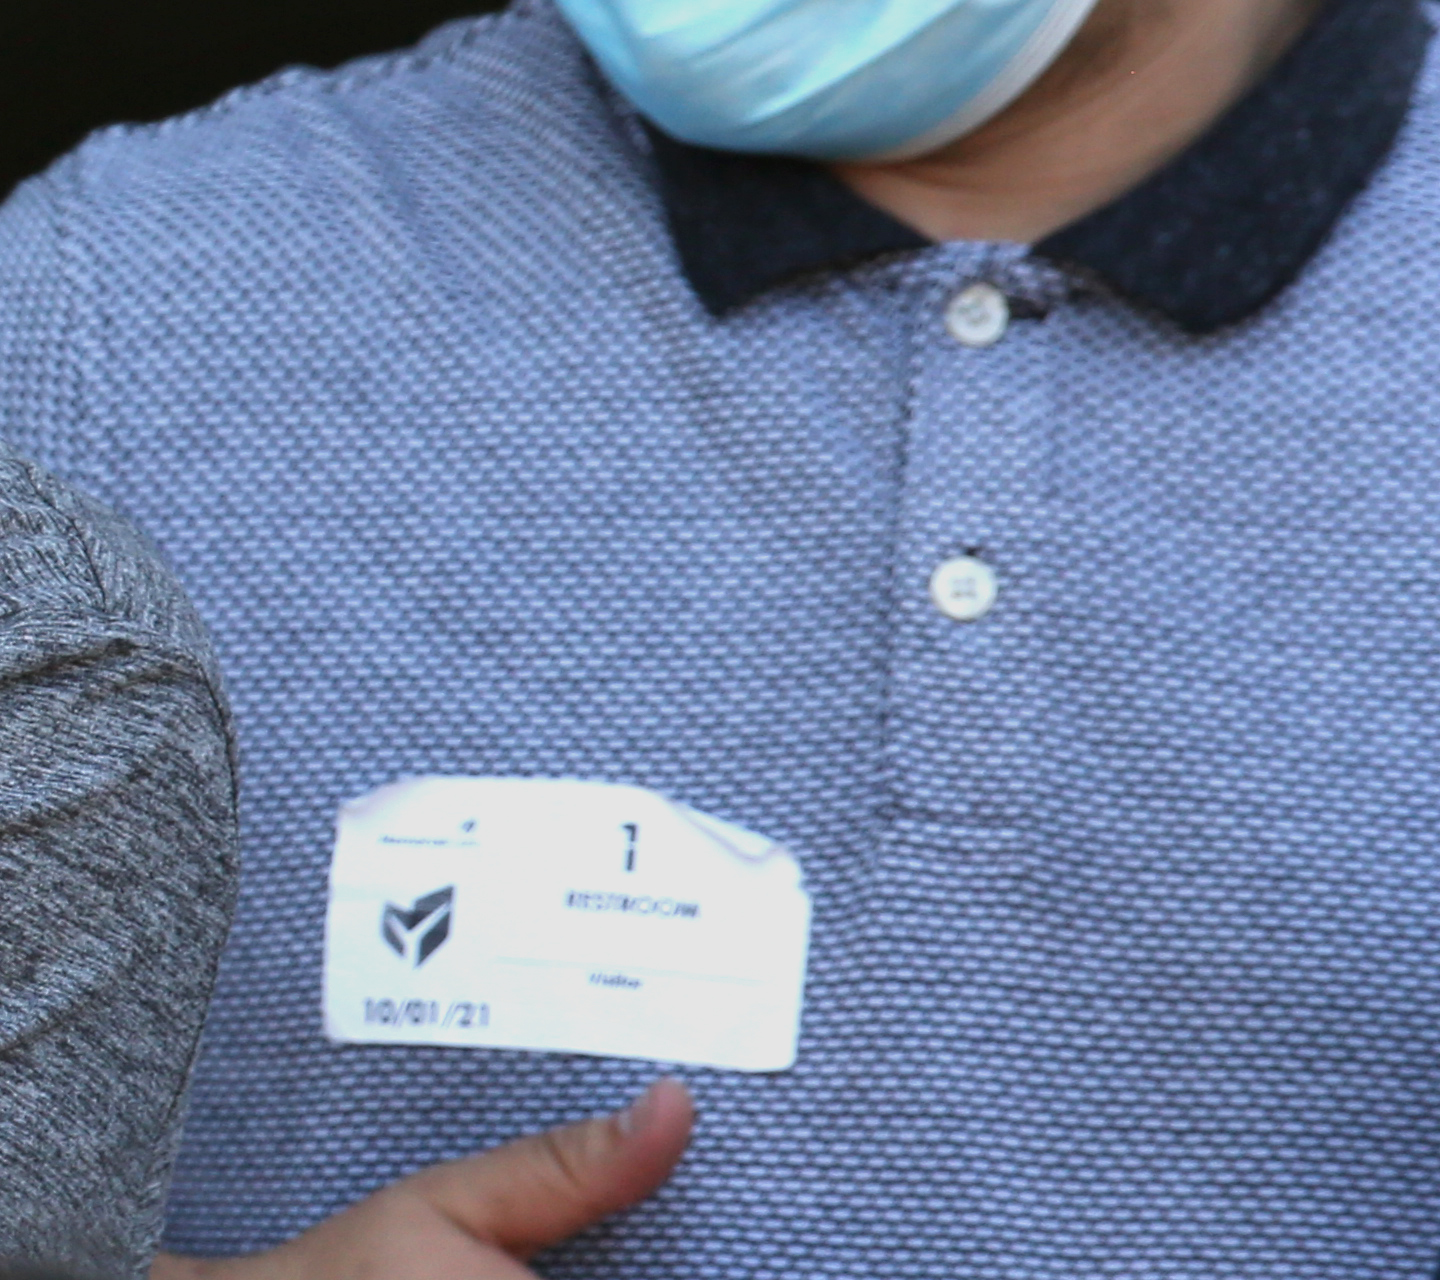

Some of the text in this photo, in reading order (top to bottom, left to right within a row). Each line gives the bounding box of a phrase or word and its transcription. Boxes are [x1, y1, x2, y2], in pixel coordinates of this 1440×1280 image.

[620, 821, 640, 873] 1
[566, 889, 701, 919] RESTROOM
[363, 996, 491, 1028] 10/01/21
